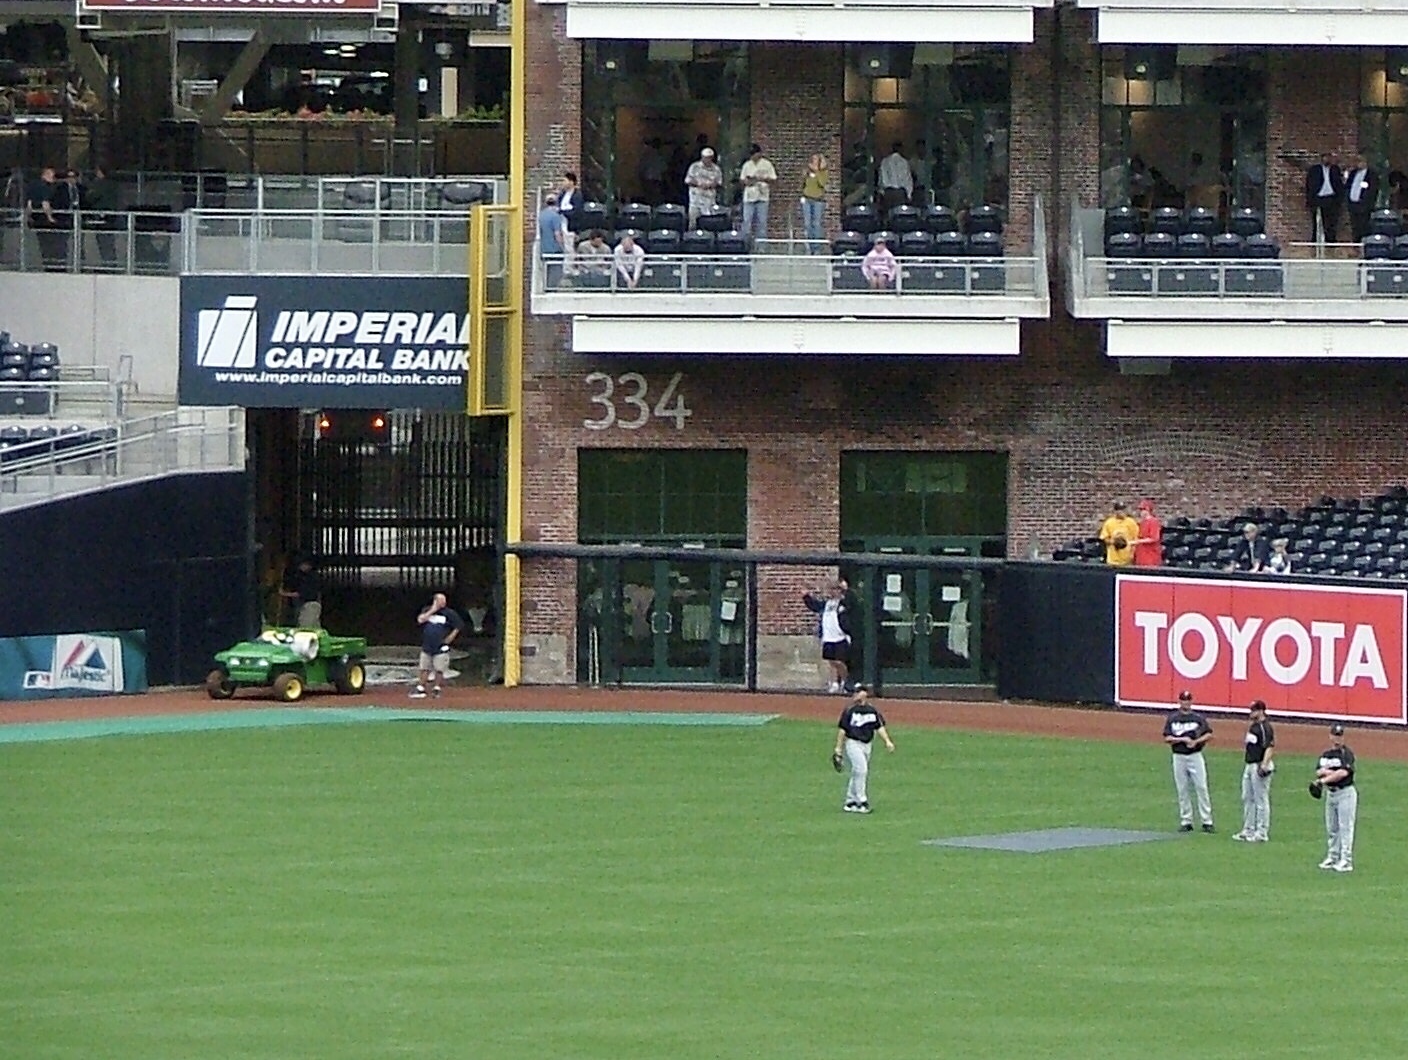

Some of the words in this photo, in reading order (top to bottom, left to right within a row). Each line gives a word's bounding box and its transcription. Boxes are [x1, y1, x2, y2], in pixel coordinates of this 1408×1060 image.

[214, 371, 463, 386] www.imperialcapitalbank.com
[263, 347, 384, 370] CAPITAL
[582, 371, 693, 431] 334
[1134, 610, 1390, 690] TOYOTA
